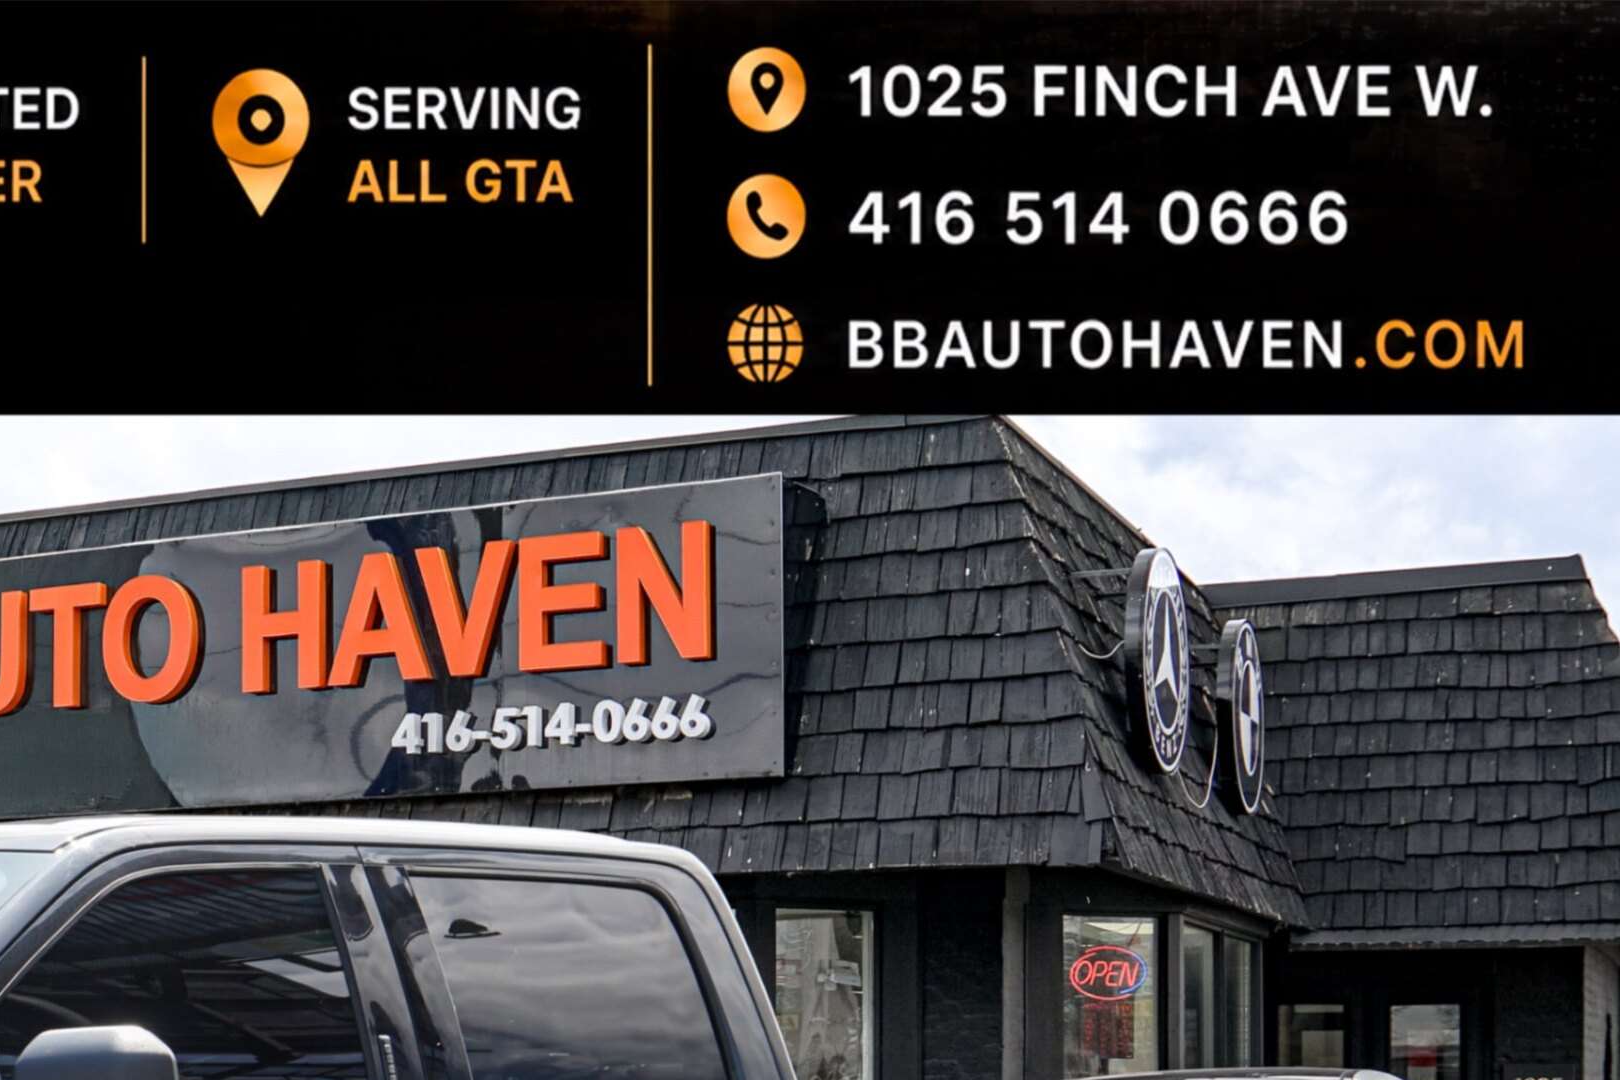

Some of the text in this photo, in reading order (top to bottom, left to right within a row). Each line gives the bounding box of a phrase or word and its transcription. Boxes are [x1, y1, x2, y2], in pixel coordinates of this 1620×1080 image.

[241, 519, 713, 693] HAVEN
[392, 693, 712, 754] 416-514-0666
[1074, 960, 1140, 987] OPEN
